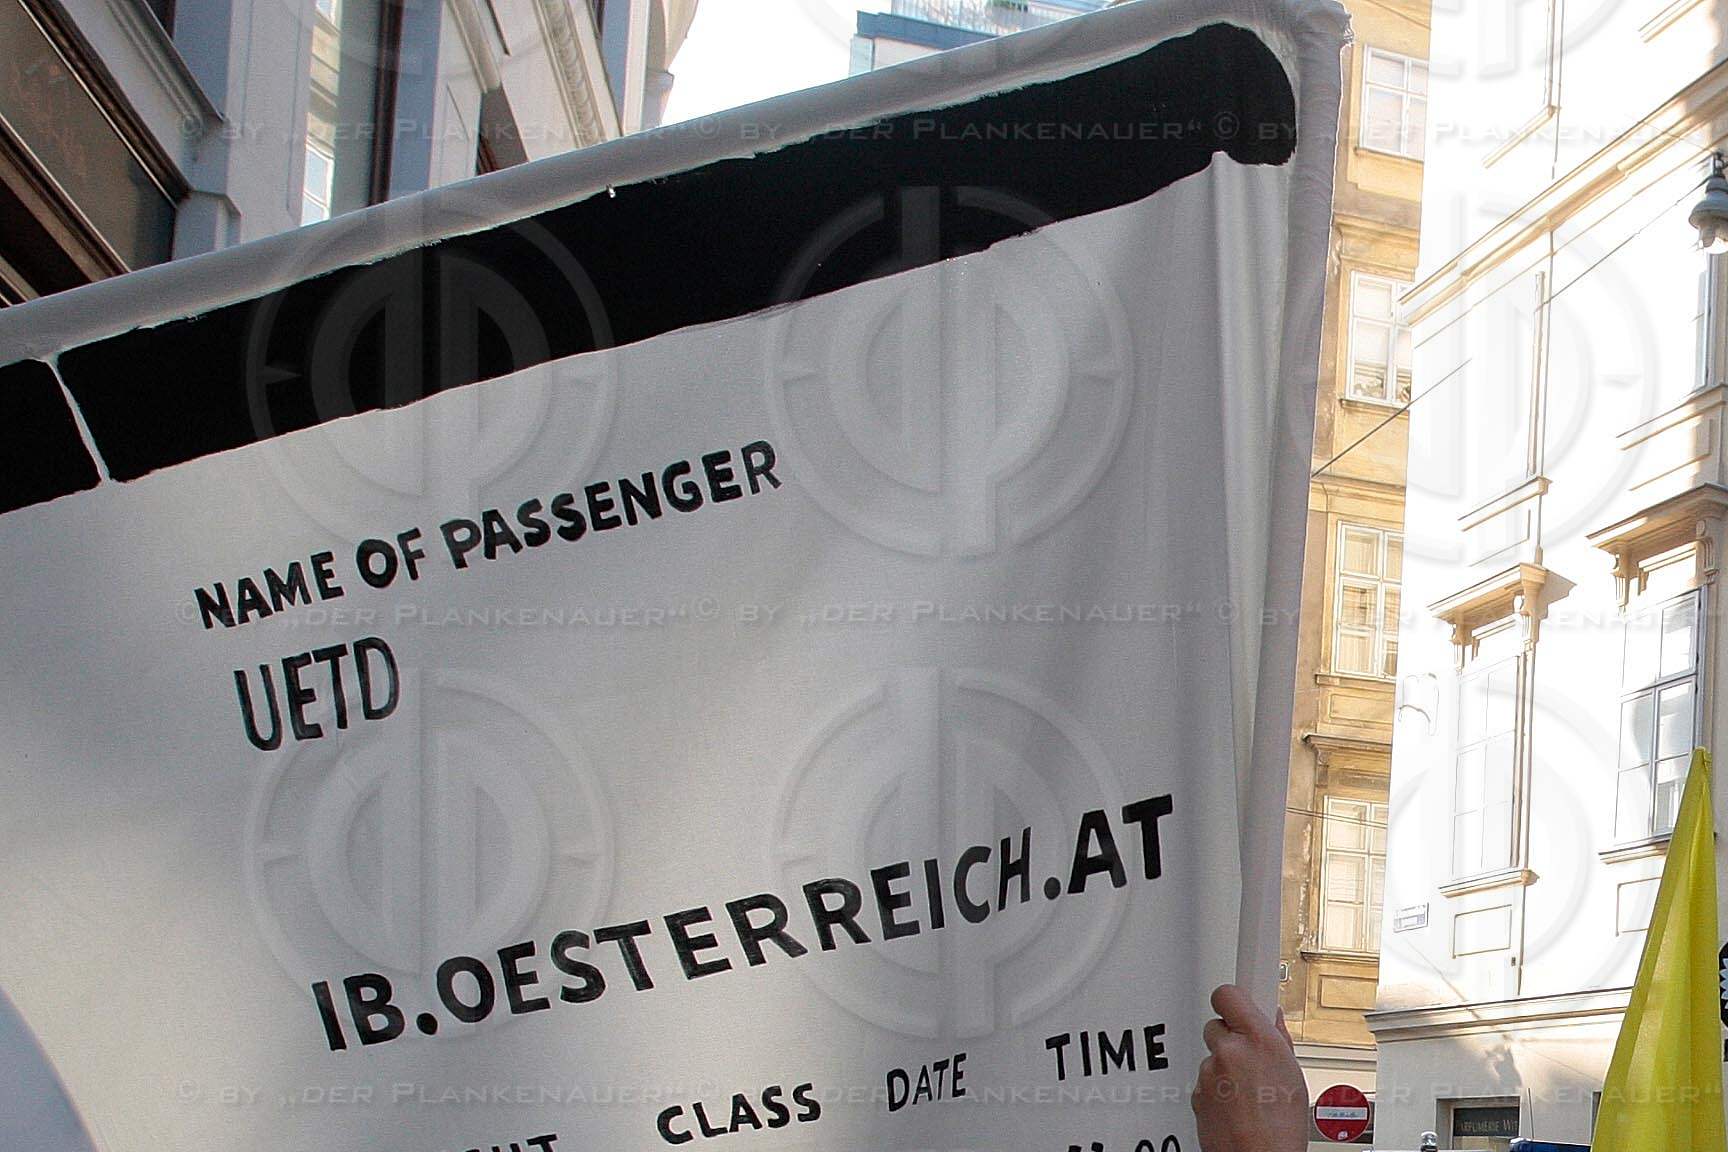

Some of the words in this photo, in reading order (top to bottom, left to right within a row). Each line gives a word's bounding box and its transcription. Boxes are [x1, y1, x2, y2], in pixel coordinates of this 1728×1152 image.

[193, 552, 343, 629] NAME
[357, 528, 426, 588] OF
[440, 441, 782, 570] PASSENGER
[233, 637, 400, 751] UETD
[313, 794, 1174, 1053] IB.OESTERREICH.AT
[655, 1083, 822, 1145] CLASS
[885, 1053, 967, 1113] DATE
[1045, 1023, 1168, 1082] TIME
